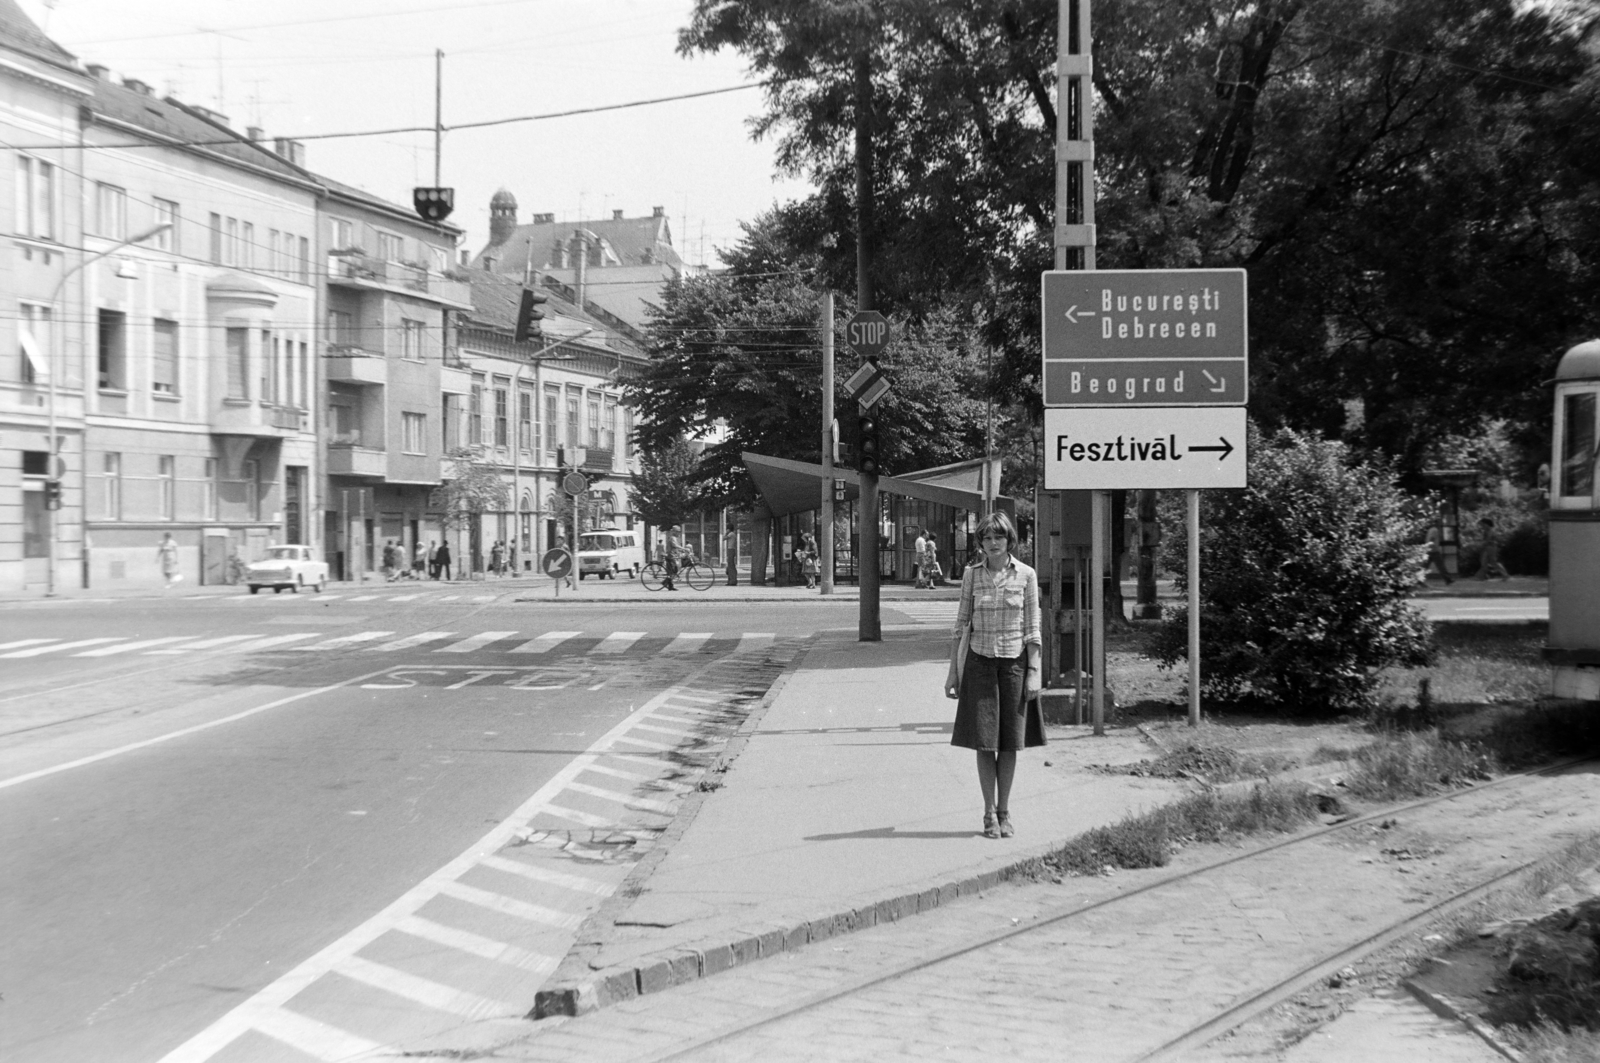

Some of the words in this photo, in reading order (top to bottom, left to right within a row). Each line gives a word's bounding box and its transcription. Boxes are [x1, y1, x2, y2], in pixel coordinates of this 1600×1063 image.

[851, 321, 886, 345] STOP
[1102, 316, 1217, 338] Debrecen
[1071, 370, 1184, 399] Beograd
